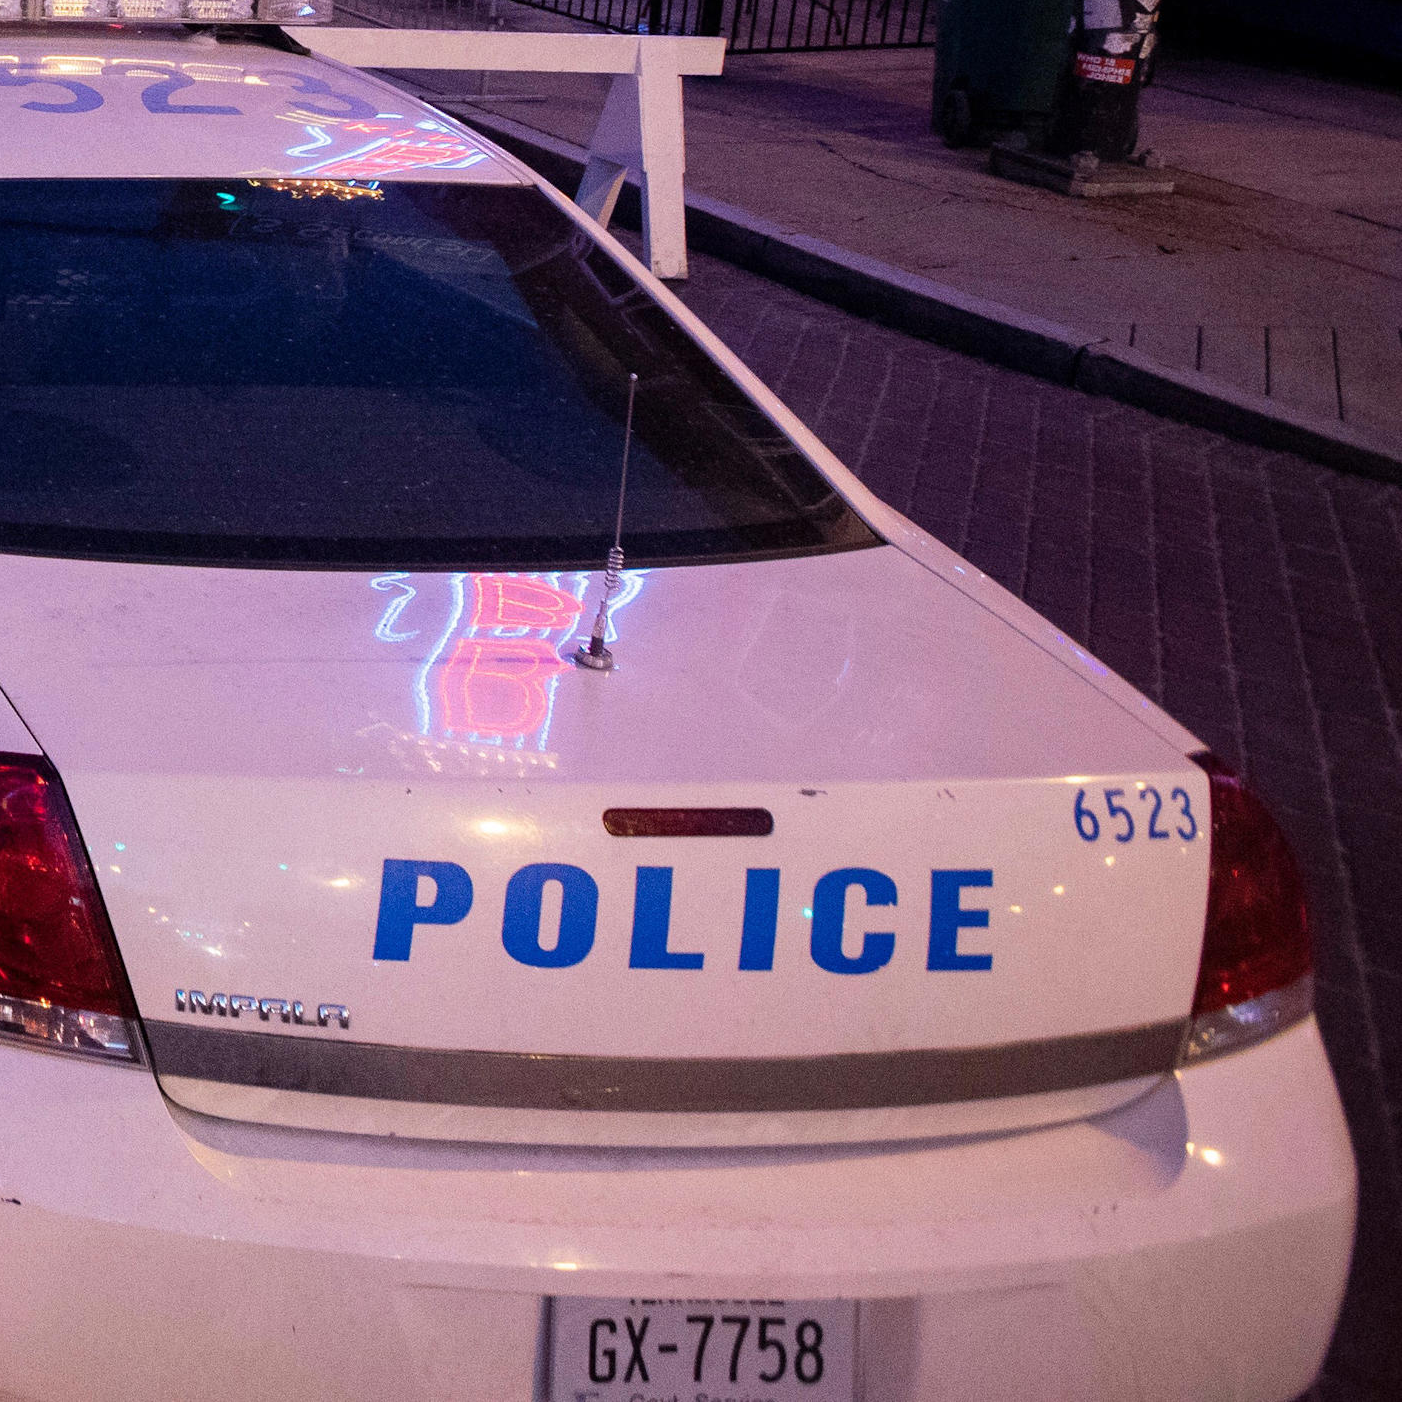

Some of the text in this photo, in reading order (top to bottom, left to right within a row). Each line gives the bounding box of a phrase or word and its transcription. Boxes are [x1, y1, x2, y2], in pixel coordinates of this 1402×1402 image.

[1074, 786, 1197, 843] 6523
[373, 858, 995, 975] POLICE
[176, 989, 349, 1030] IMPALA
[589, 1315, 824, 1385] GX-7758
